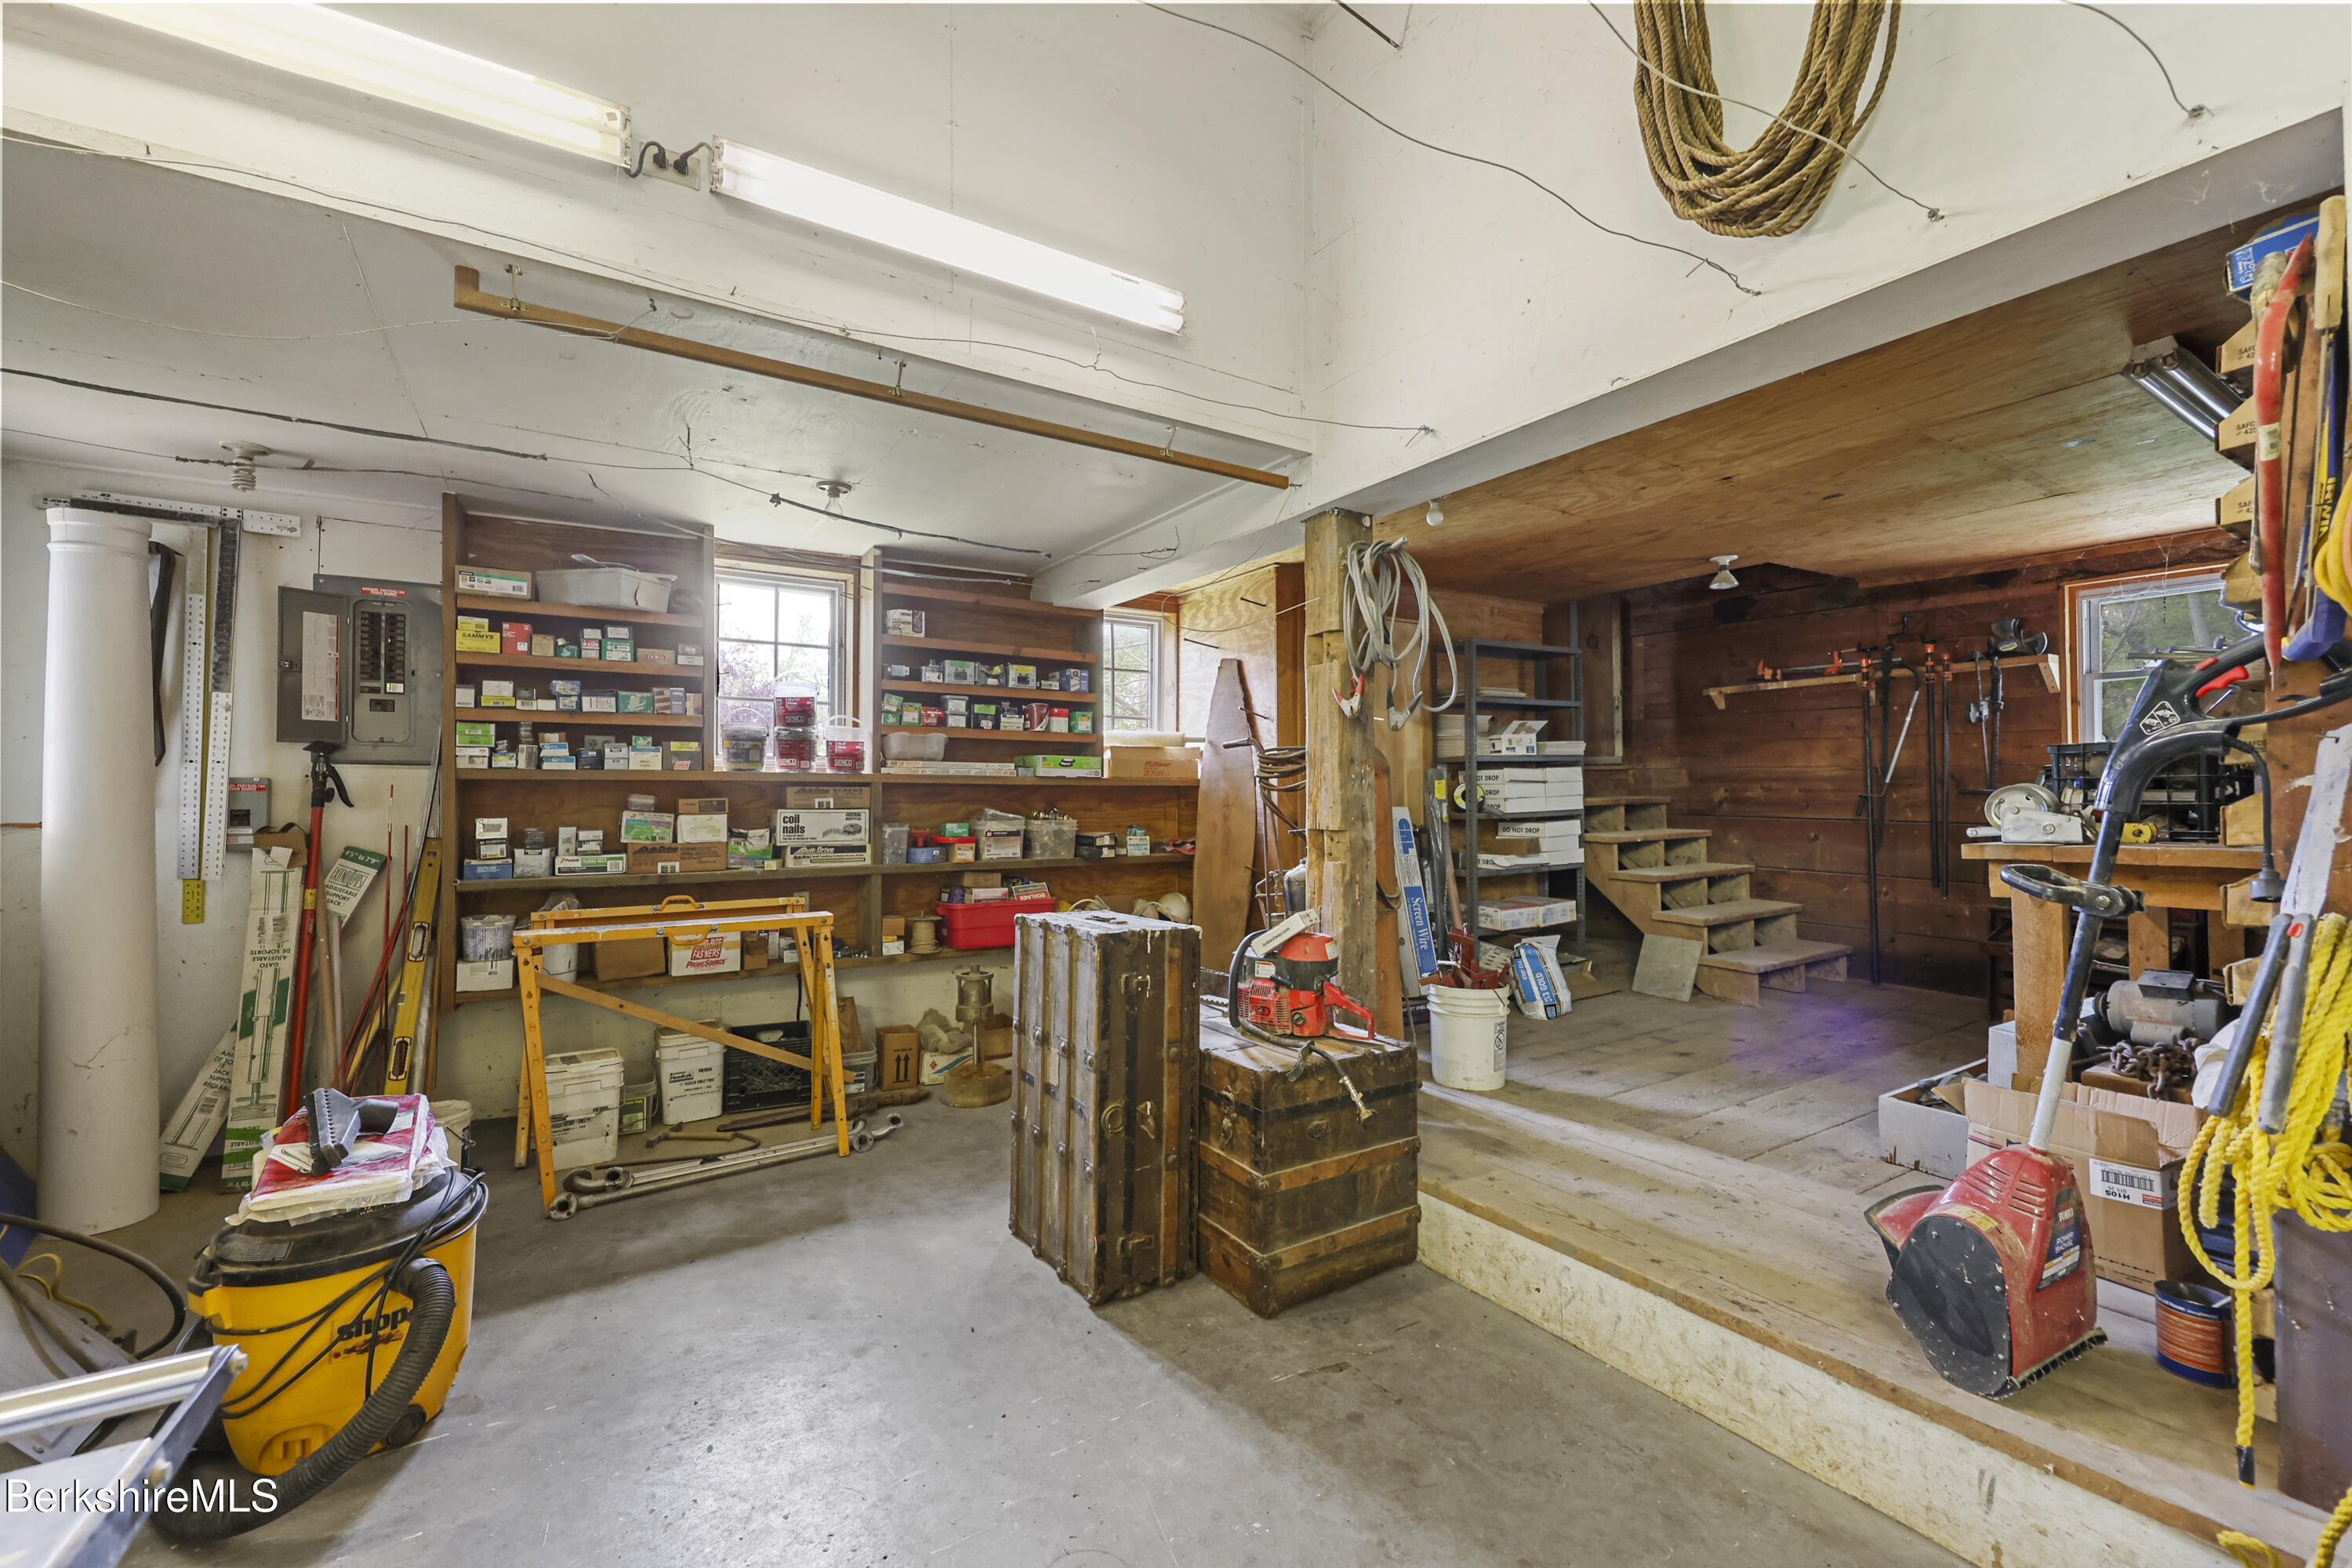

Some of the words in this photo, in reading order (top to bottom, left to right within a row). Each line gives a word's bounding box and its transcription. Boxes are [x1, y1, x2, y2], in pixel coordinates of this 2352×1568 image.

[786, 715, 805, 724] SENCO
[782, 814, 800, 824] coil
[782, 824, 806, 834] nails
[325, 884, 358, 898] ADJUSTABLE
[325, 890, 350, 902] SUPPORT
[1019, 892, 1047, 901] SCHLAGE
[1411, 897, 1424, 927] Screen
[1417, 927, 1430, 951] Wire
[1536, 972, 1548, 991] GOLD
[2105, 1189, 2130, 1200] H10S
[2059, 1207, 2074, 1222] TORO
[2056, 1232, 2074, 1245] POWER
[2055, 1240, 2074, 1254] SHOVEL
